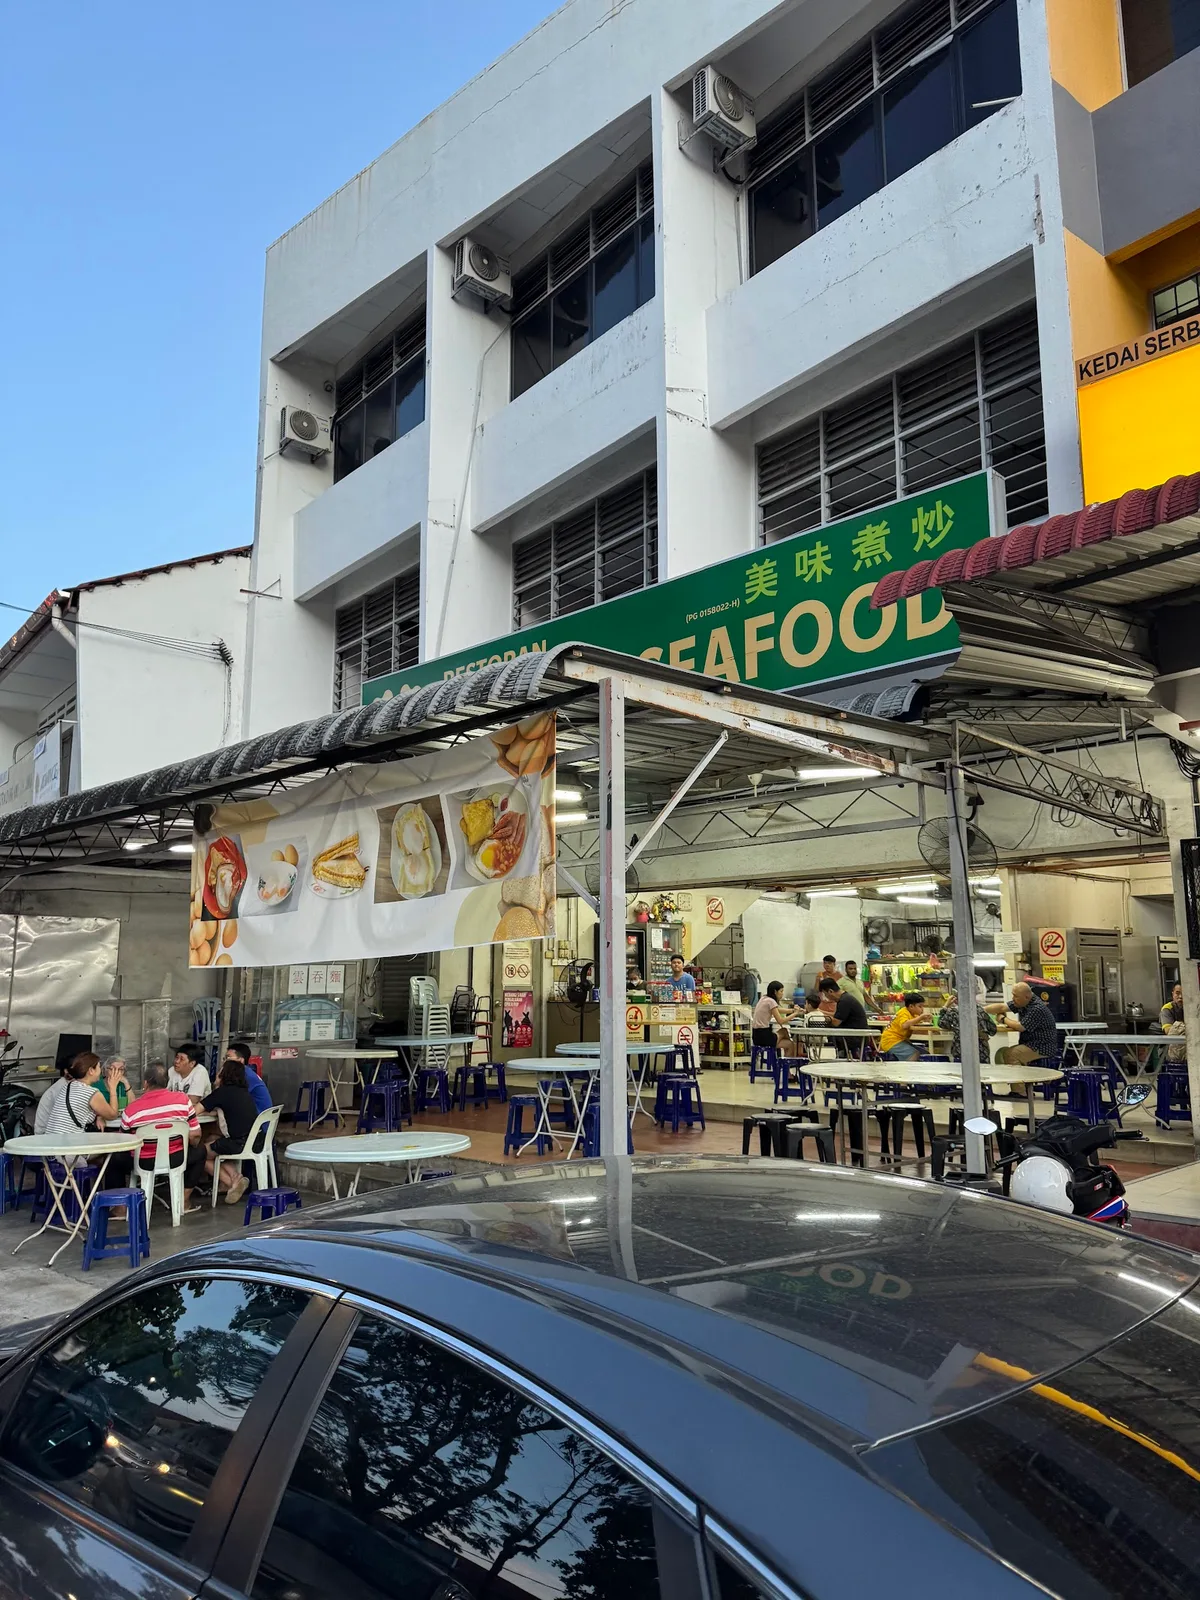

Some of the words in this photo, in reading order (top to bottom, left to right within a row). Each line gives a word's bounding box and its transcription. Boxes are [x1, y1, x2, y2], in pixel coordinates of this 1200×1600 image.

[1079, 342, 1139, 380] KEDAI
[1145, 320, 1200, 355] SERB
[745, 500, 955, 604] 美味煮炒
[685, 612, 698, 624] (PG
[700, 597, 740, 618] 0158022-H)
